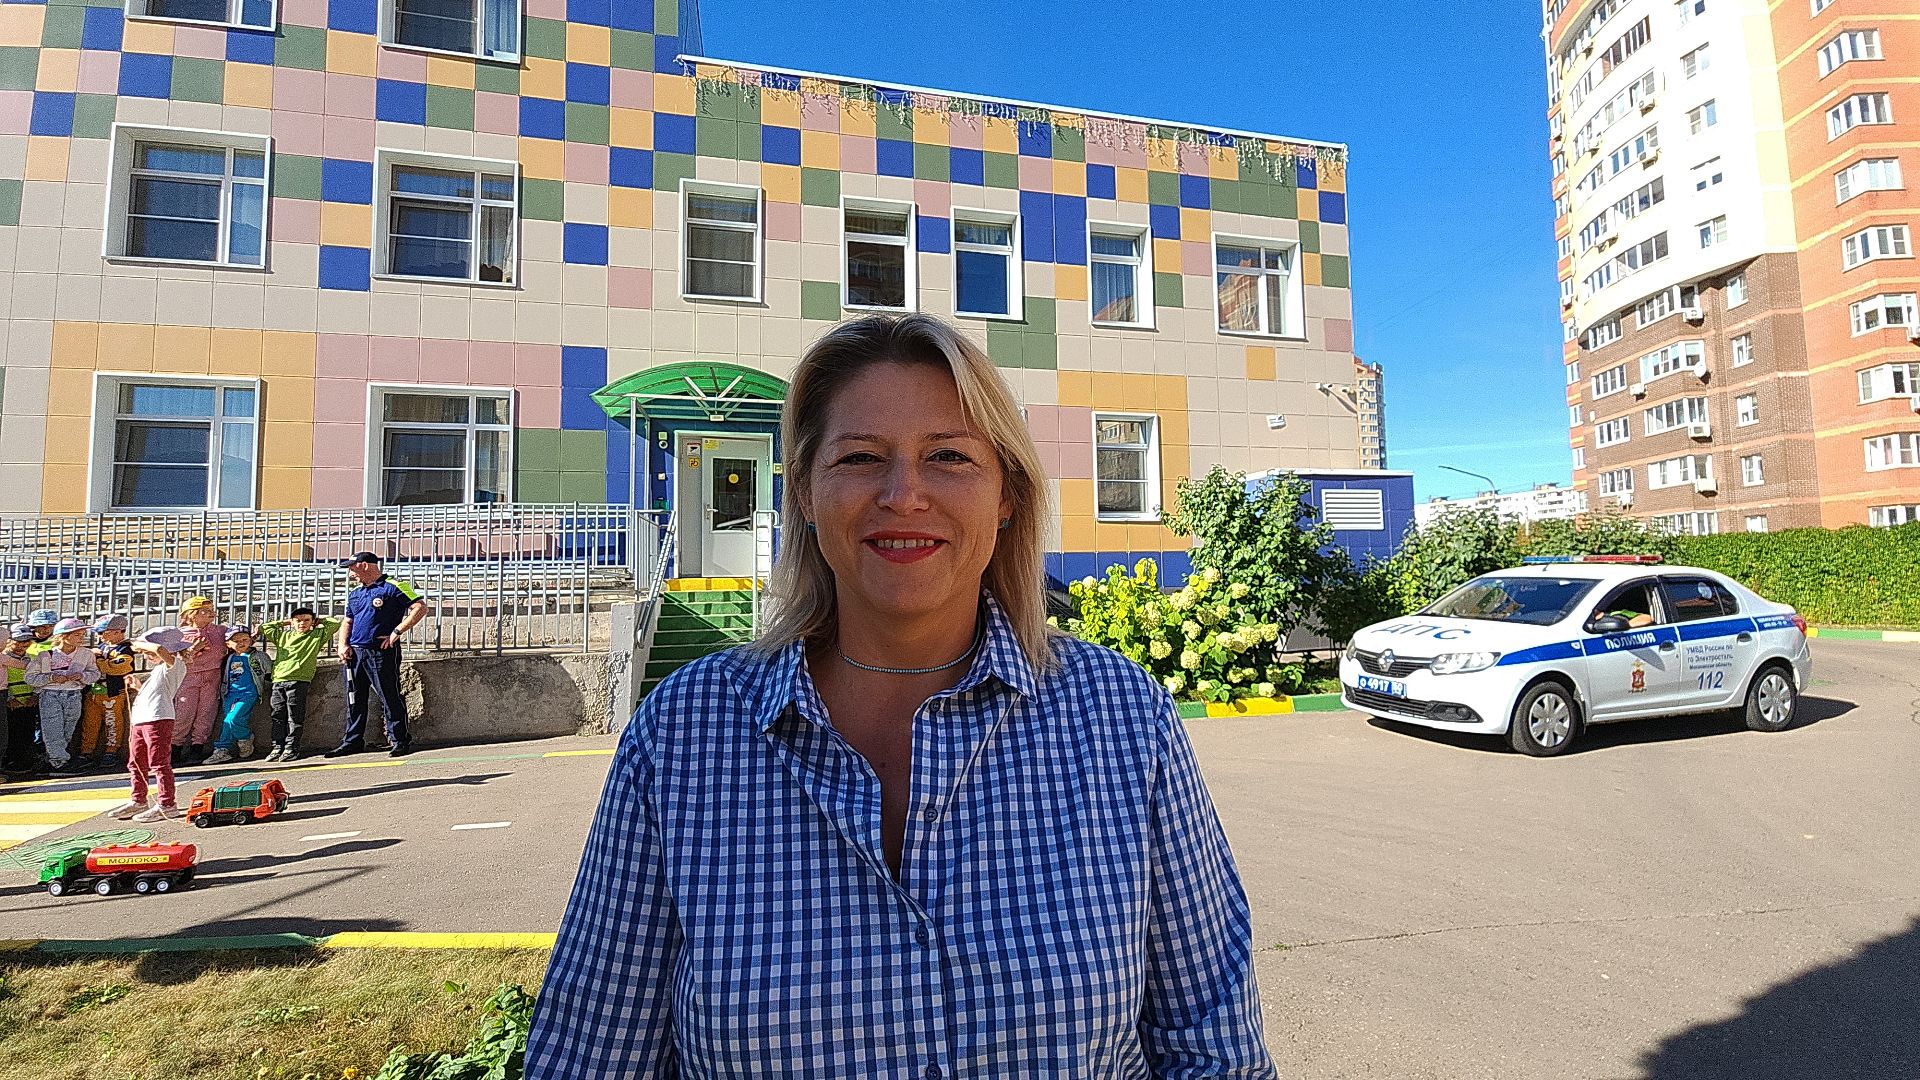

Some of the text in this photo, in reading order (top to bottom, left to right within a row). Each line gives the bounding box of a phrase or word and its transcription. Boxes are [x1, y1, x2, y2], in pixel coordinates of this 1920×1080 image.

[1370, 623, 1472, 640] ДПС
[1604, 632, 1657, 650] ПОЛИЦИЯ
[1367, 678, 1390, 692] 4917
[1698, 671, 1724, 690] 112
[108, 856, 159, 865] МОЛОКО
